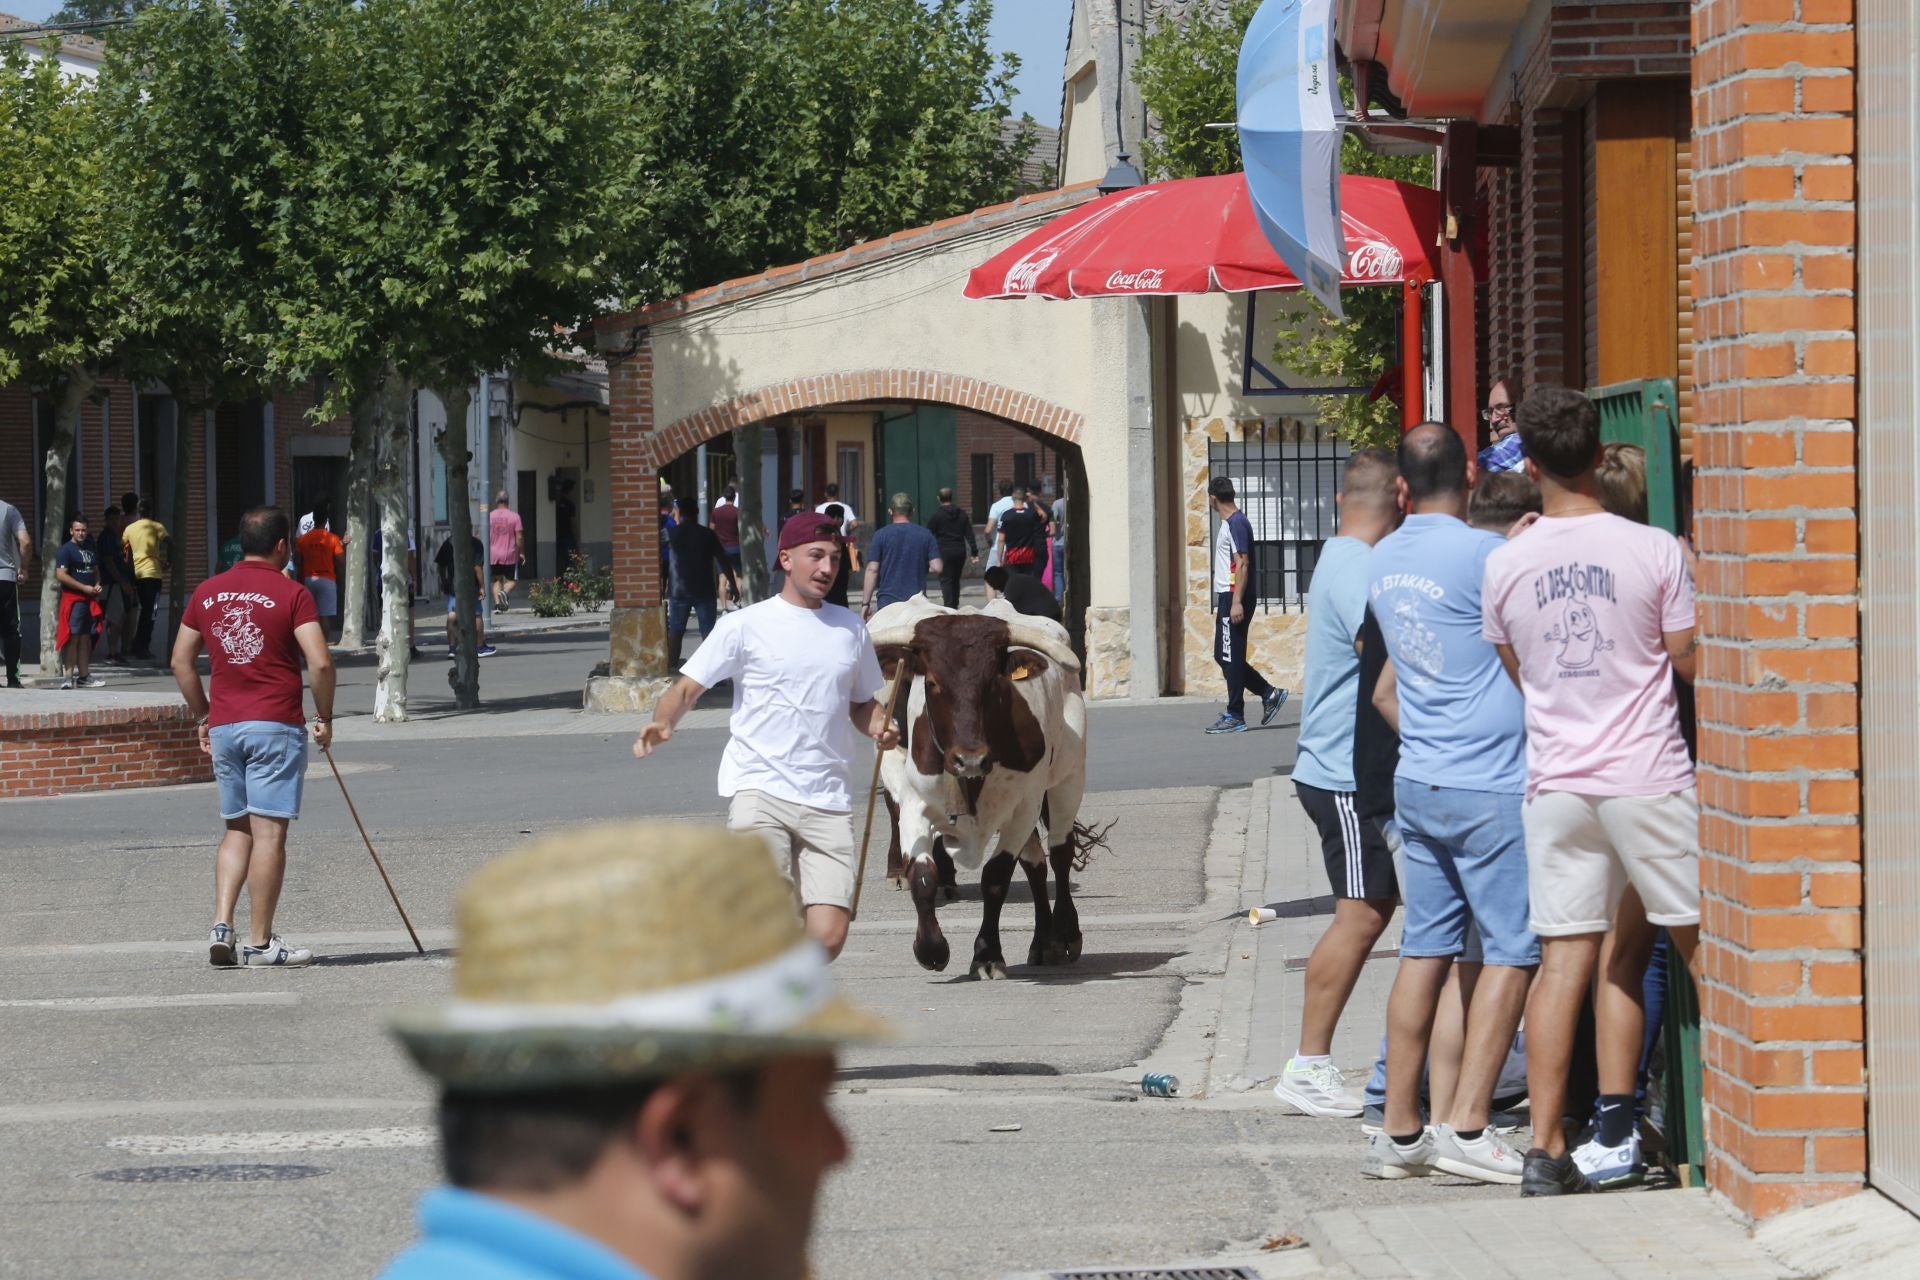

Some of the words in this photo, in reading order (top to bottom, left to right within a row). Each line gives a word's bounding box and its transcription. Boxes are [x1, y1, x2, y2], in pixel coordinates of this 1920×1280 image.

[1105, 268, 1167, 290] Coca-Cola
[202, 597, 215, 610] EL
[217, 592, 276, 609] ESTAKAZO
[1535, 576, 1548, 610] EL
[1222, 616, 1232, 663] LEGEA
